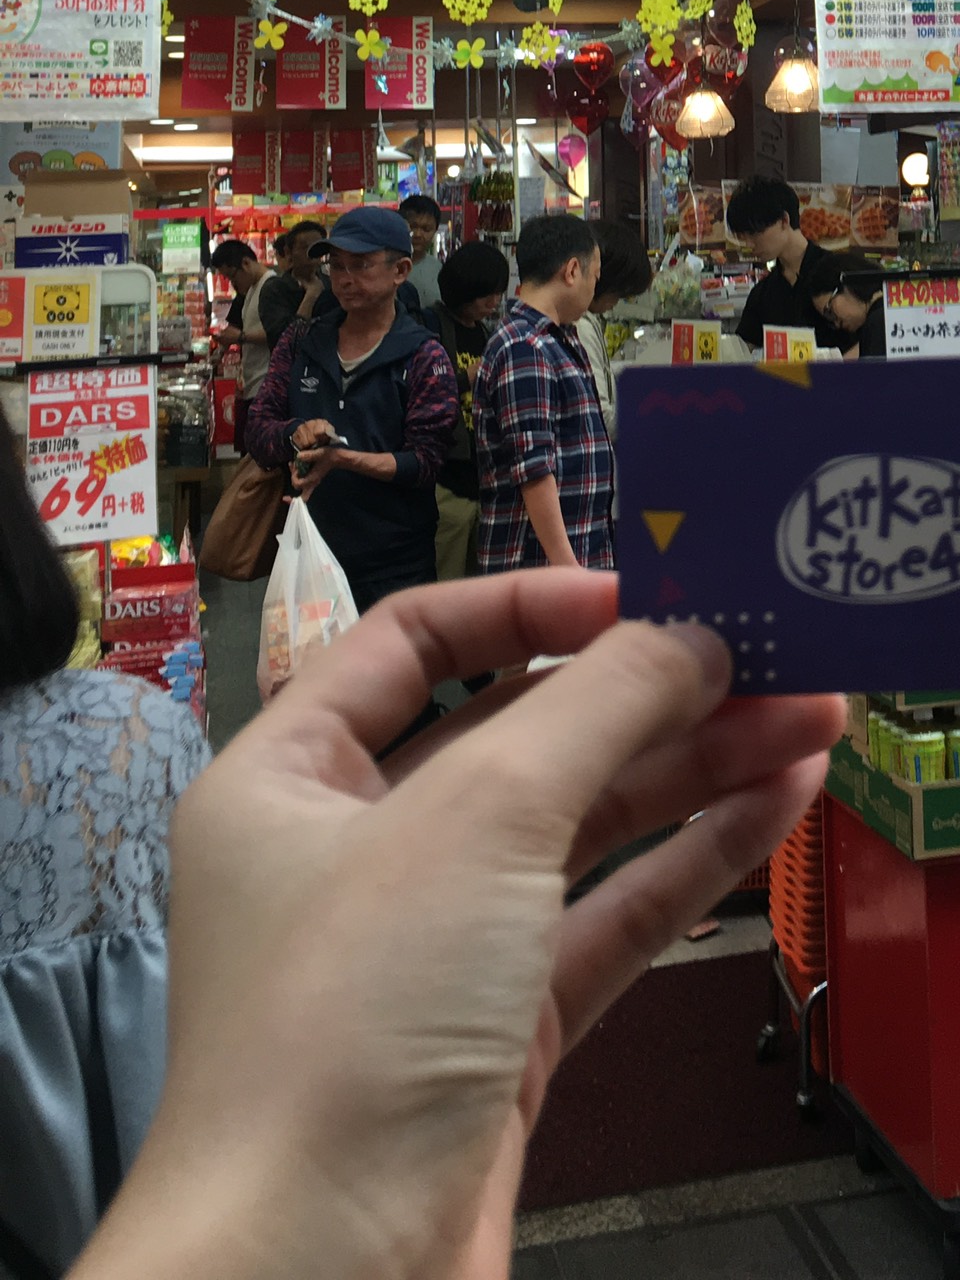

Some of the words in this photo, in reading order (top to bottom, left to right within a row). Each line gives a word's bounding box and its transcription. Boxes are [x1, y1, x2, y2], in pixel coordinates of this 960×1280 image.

[235, 22, 253, 107] Welcome
[36, 368, 142, 393] 超特価
[40, 401, 137, 428] DARS
[29, 437, 80, 456] 定価110円を
[39, 467, 108, 523] 69
[104, 599, 161, 621] DARS
